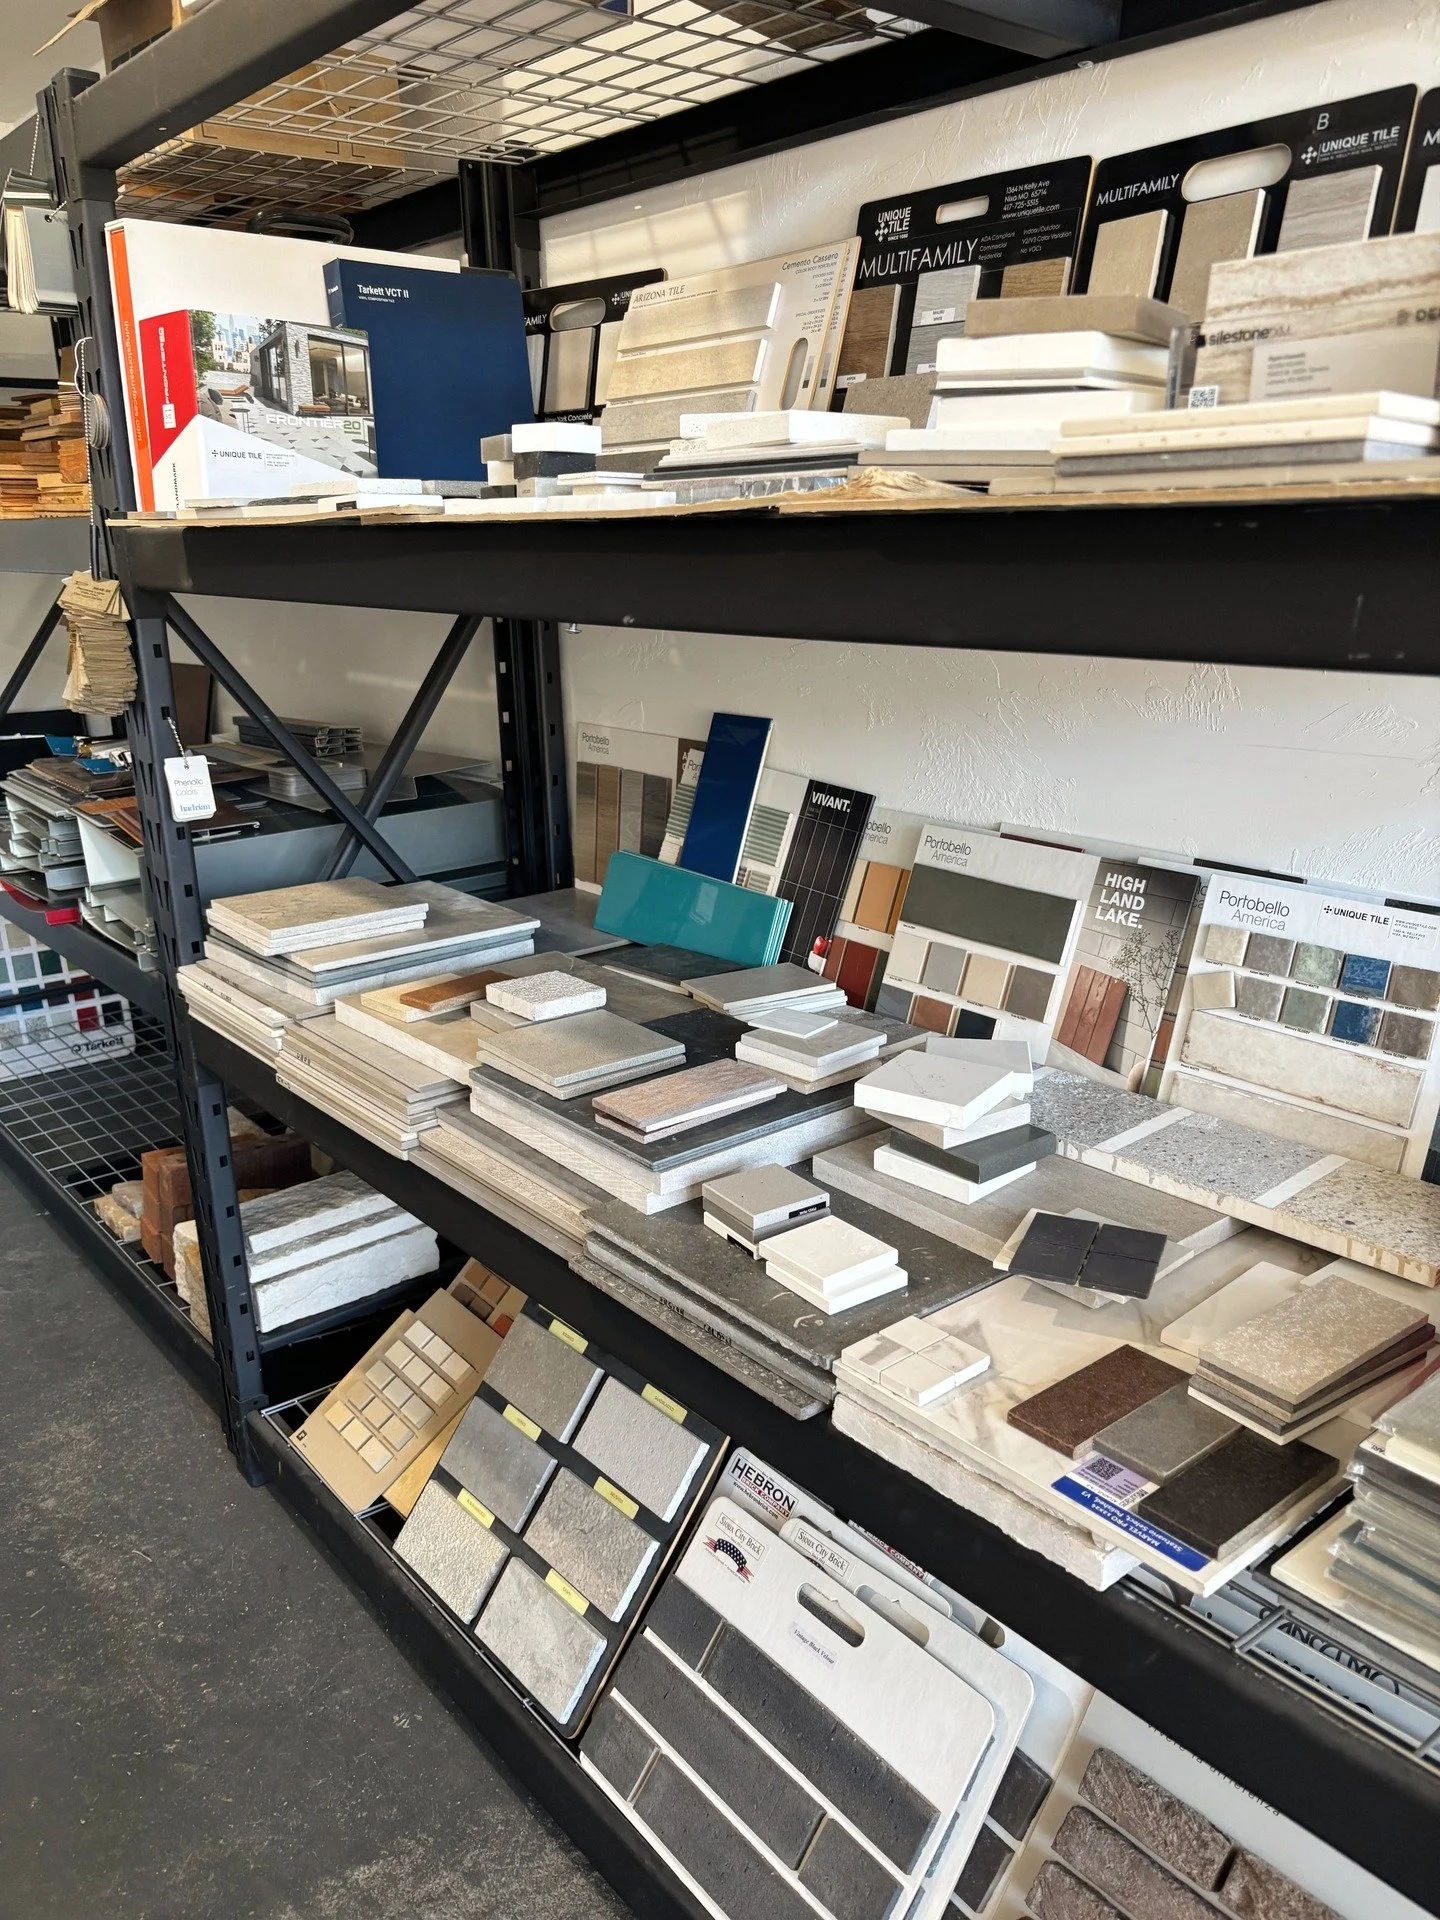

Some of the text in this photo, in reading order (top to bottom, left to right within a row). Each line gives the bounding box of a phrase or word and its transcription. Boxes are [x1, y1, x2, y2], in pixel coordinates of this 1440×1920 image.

[1317, 113, 1329, 131] B
[1321, 132, 1369, 153] UNIQUE
[1372, 126, 1400, 141] TILE
[1018, 192, 1029, 200] MO
[1096, 173, 1180, 206] MULTIFAMILY
[877, 206, 912, 223] UNIQUE
[1001, 203, 1060, 220] www.uniquetile.com
[888, 218, 910, 233] TILE
[782, 252, 839, 271] Cemento Cassero
[859, 238, 979, 280] MULTIFAMILY
[357, 284, 410, 299] Tarkett VCT II
[634, 287, 667, 304] ARIZONA
[669, 285, 686, 295] TILE
[1209, 327, 1270, 347] silestone
[568, 412, 593, 422] Concrete
[219, 450, 247, 459] UNIQUE
[248, 452, 263, 460] TILE
[581, 732, 610, 747] Portobello
[587, 744, 610, 755] America
[173, 779, 204, 787] Phenolic
[175, 788, 199, 797] Colors
[811, 791, 851, 813] VIVANT.
[923, 835, 972, 856] Portobello
[930, 850, 969, 868] America
[1104, 872, 1147, 894] HIGH
[1099, 889, 1145, 911] LAND
[1218, 890, 1291, 918] Portobello
[1094, 905, 1143, 929] LAKE.
[1231, 909, 1286, 932] America
[1333, 907, 1390, 926] UNIQUE TILE
[731, 1458, 796, 1512] HEBRON
[1081, 1490, 1091, 1498] V3
[733, 1481, 779, 1520] www.hebronbrick.com
[741, 1476, 760, 1495] BRICK
[760, 1490, 790, 1517] COMPANY
[1093, 1496, 1125, 1517] Polished,
[1111, 1514, 1127, 1528] PRO
[1125, 1515, 1148, 1530] Select,
[719, 1516, 734, 1533] Sioux
[734, 1527, 747, 1542] City
[747, 1535, 762, 1555] Brick
[1129, 1526, 1160, 1547] MARVEL
[1148, 1529, 1184, 1552] Statuario
[797, 1531, 846, 1570] Sioux City Brick
[866, 1531, 925, 1579] BRICK COMPANY
[794, 1629, 810, 1644] Vintage
[809, 1641, 821, 1654] Black
